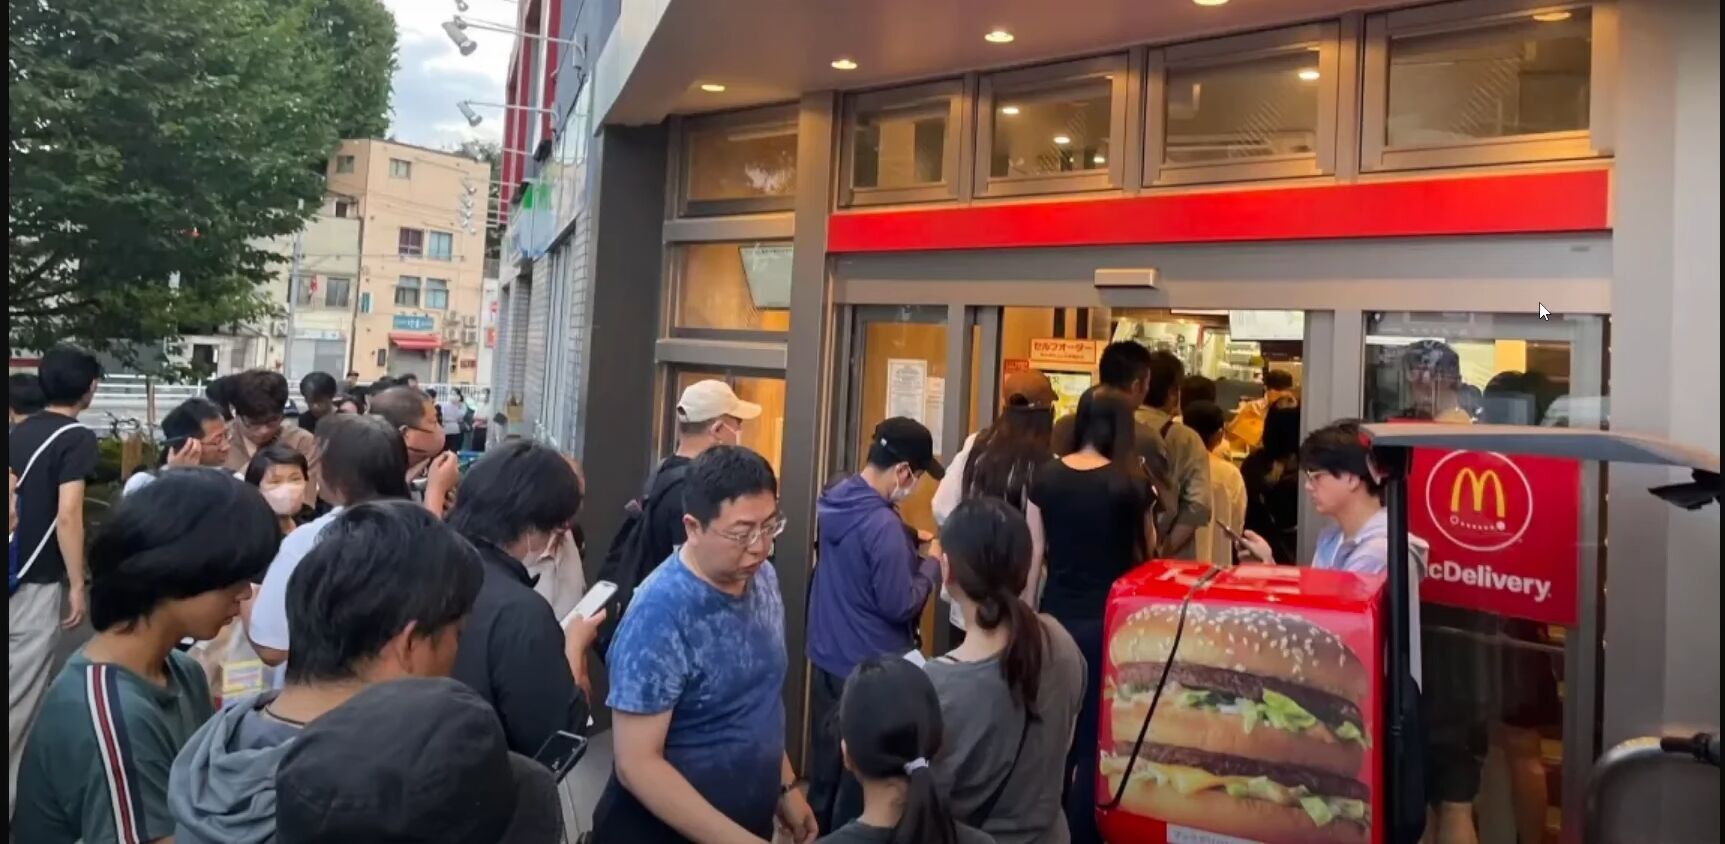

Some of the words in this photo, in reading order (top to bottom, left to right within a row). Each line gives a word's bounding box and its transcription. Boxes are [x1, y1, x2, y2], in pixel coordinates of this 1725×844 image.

[1034, 341, 1093, 353] セルフオーダー
[1424, 560, 1551, 602] cDelivery
